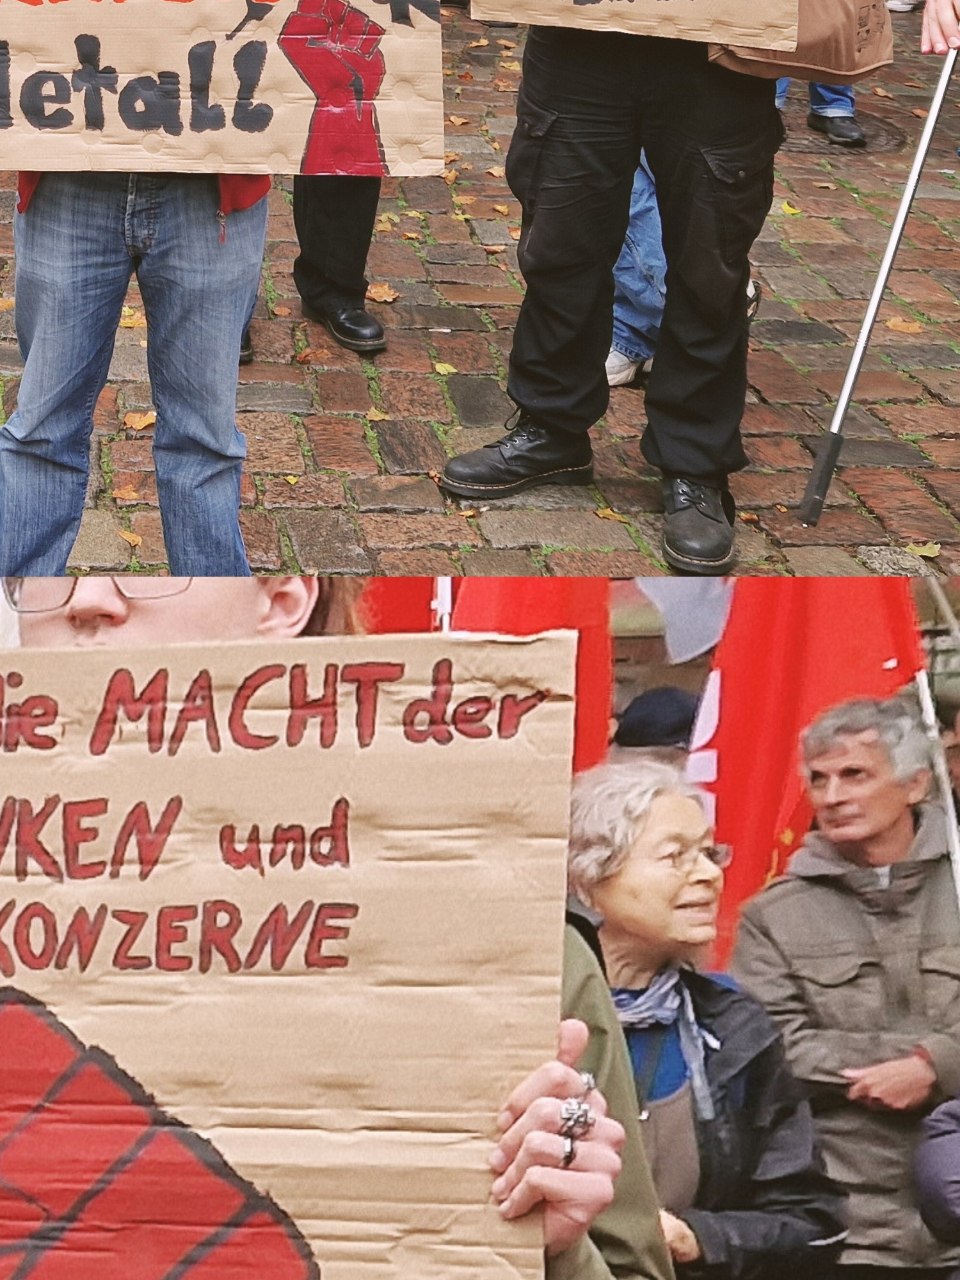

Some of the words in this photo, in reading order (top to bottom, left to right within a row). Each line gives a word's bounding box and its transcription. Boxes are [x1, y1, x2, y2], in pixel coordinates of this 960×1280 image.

[90, 661, 406, 758] MACHT
[402, 657, 554, 746] der
[219, 797, 350, 876] und
